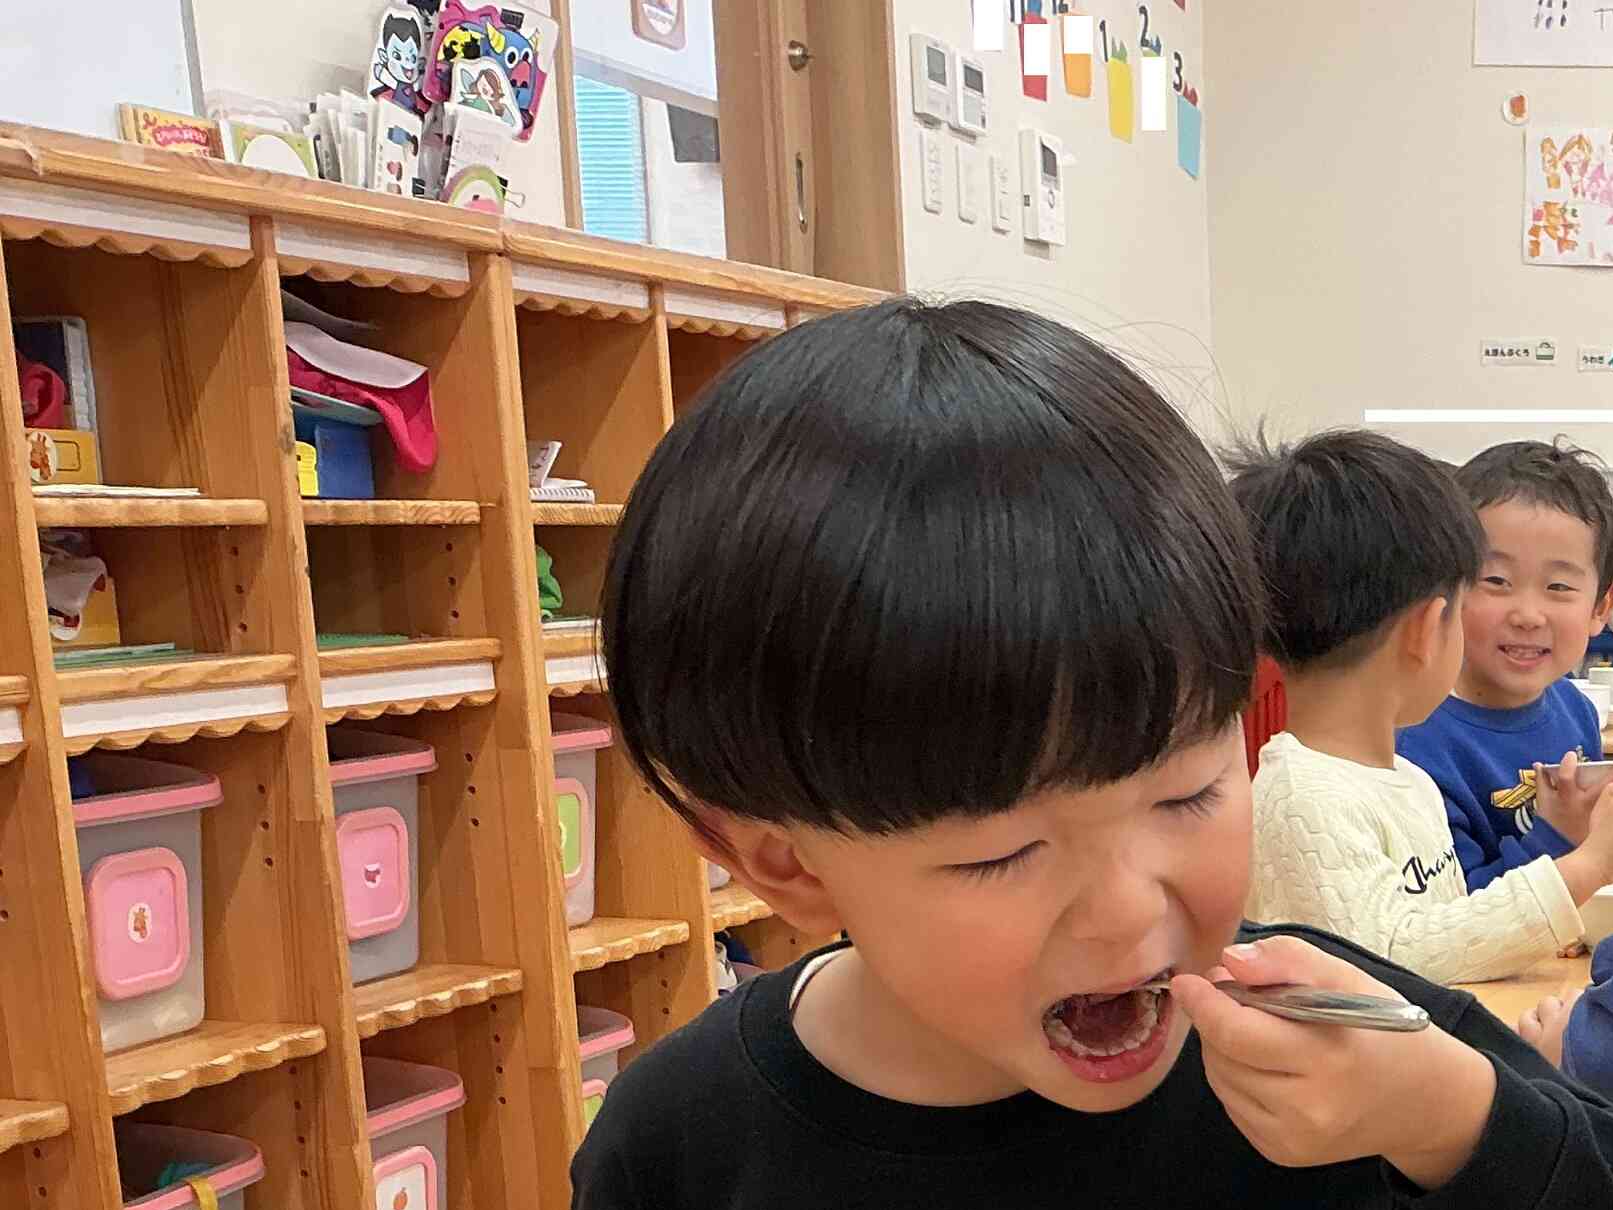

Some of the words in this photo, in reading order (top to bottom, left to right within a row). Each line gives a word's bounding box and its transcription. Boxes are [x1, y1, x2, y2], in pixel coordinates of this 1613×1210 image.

[1100, 20, 1108, 62] 1
[1139, 5, 1151, 47] 2
[1173, 51, 1183, 92] 3
